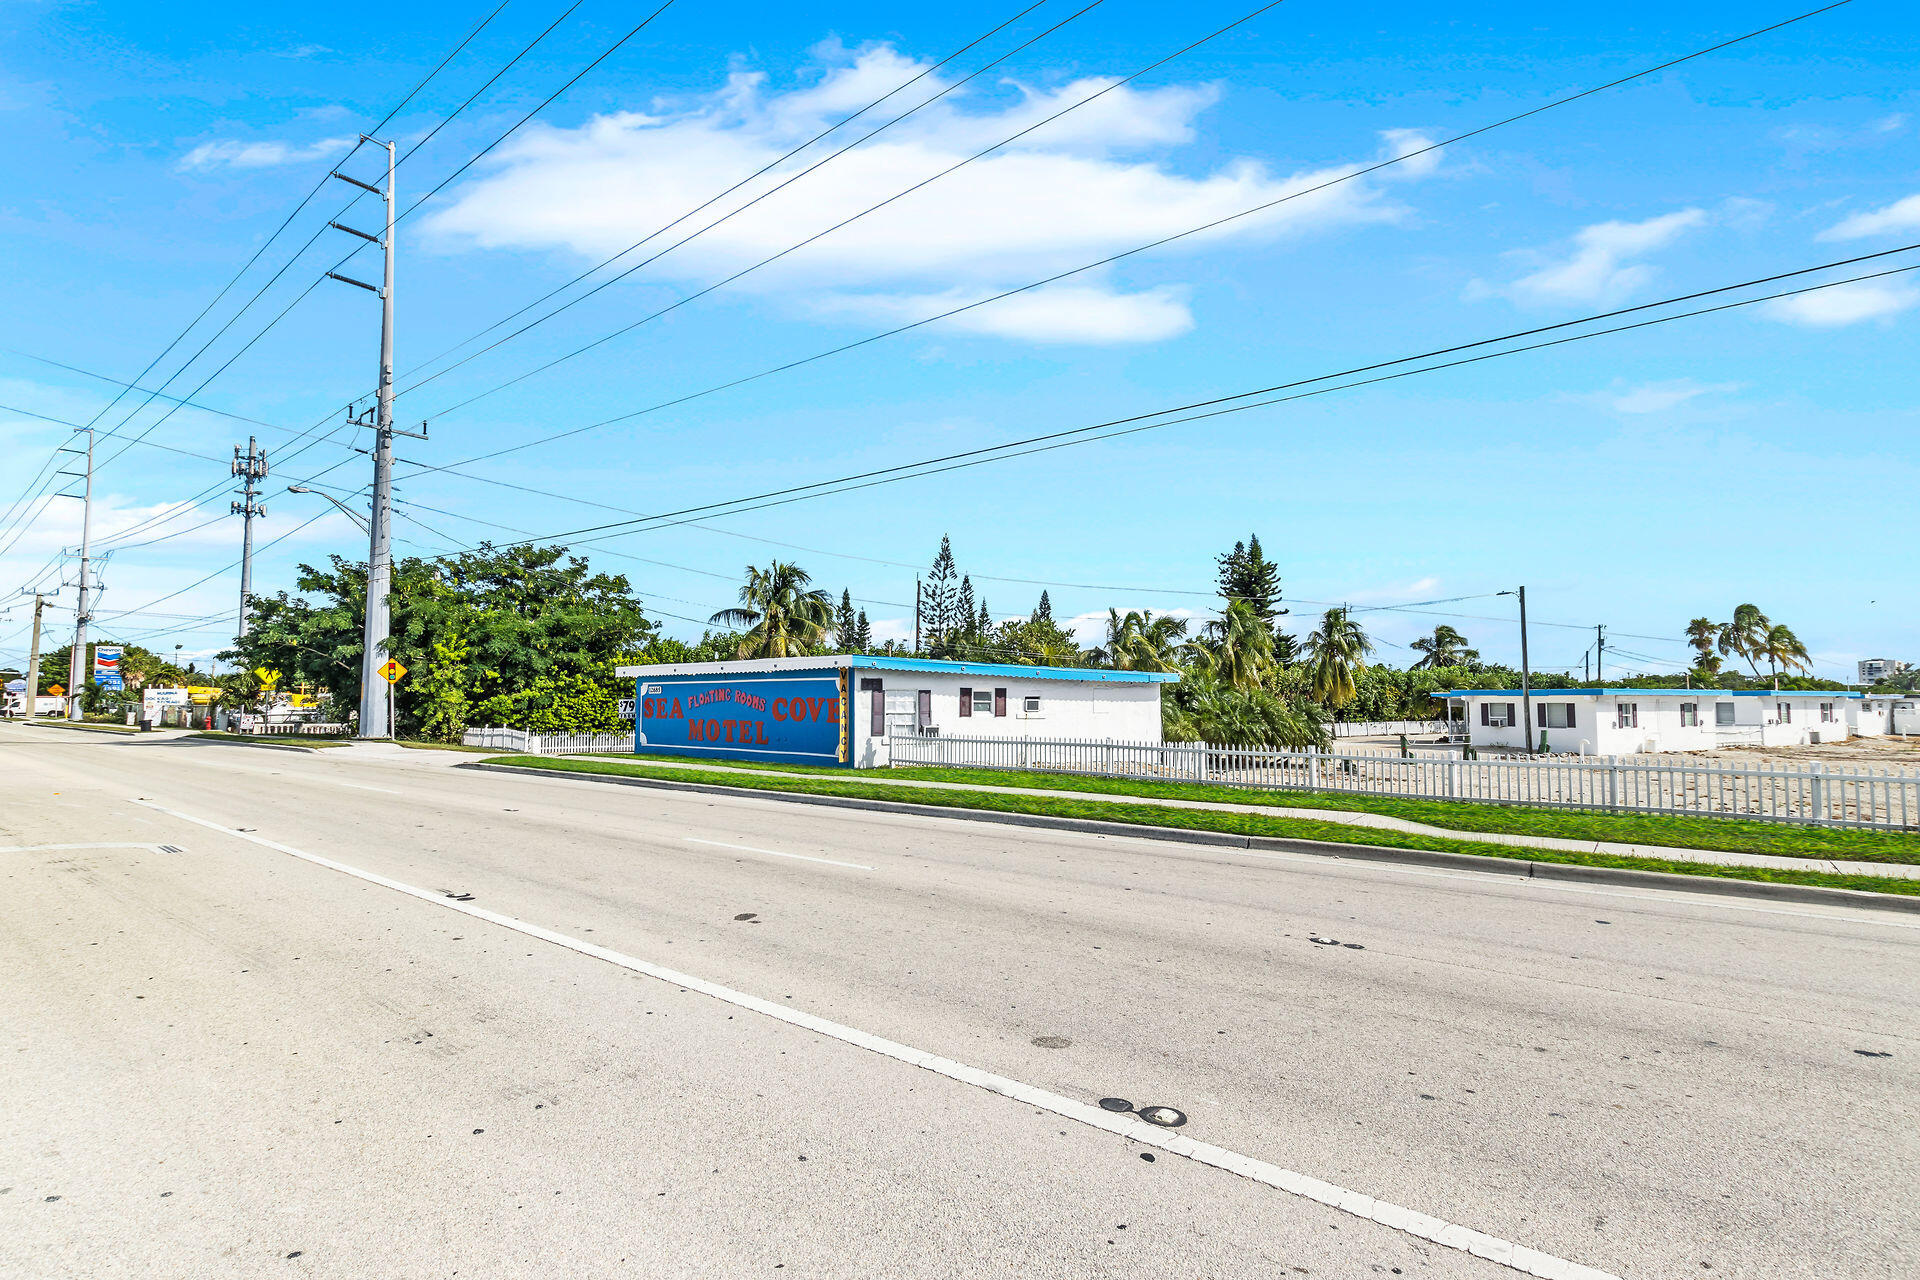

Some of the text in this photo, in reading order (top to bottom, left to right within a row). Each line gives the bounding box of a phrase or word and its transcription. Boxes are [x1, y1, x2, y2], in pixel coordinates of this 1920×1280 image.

[619, 700, 635, 712] $79
[644, 697, 840, 723] SEA COVE
[688, 688, 767, 712] FLOATING ROOMS
[839, 671, 848, 759] VACANCY
[688, 718, 769, 745] MOTEL
